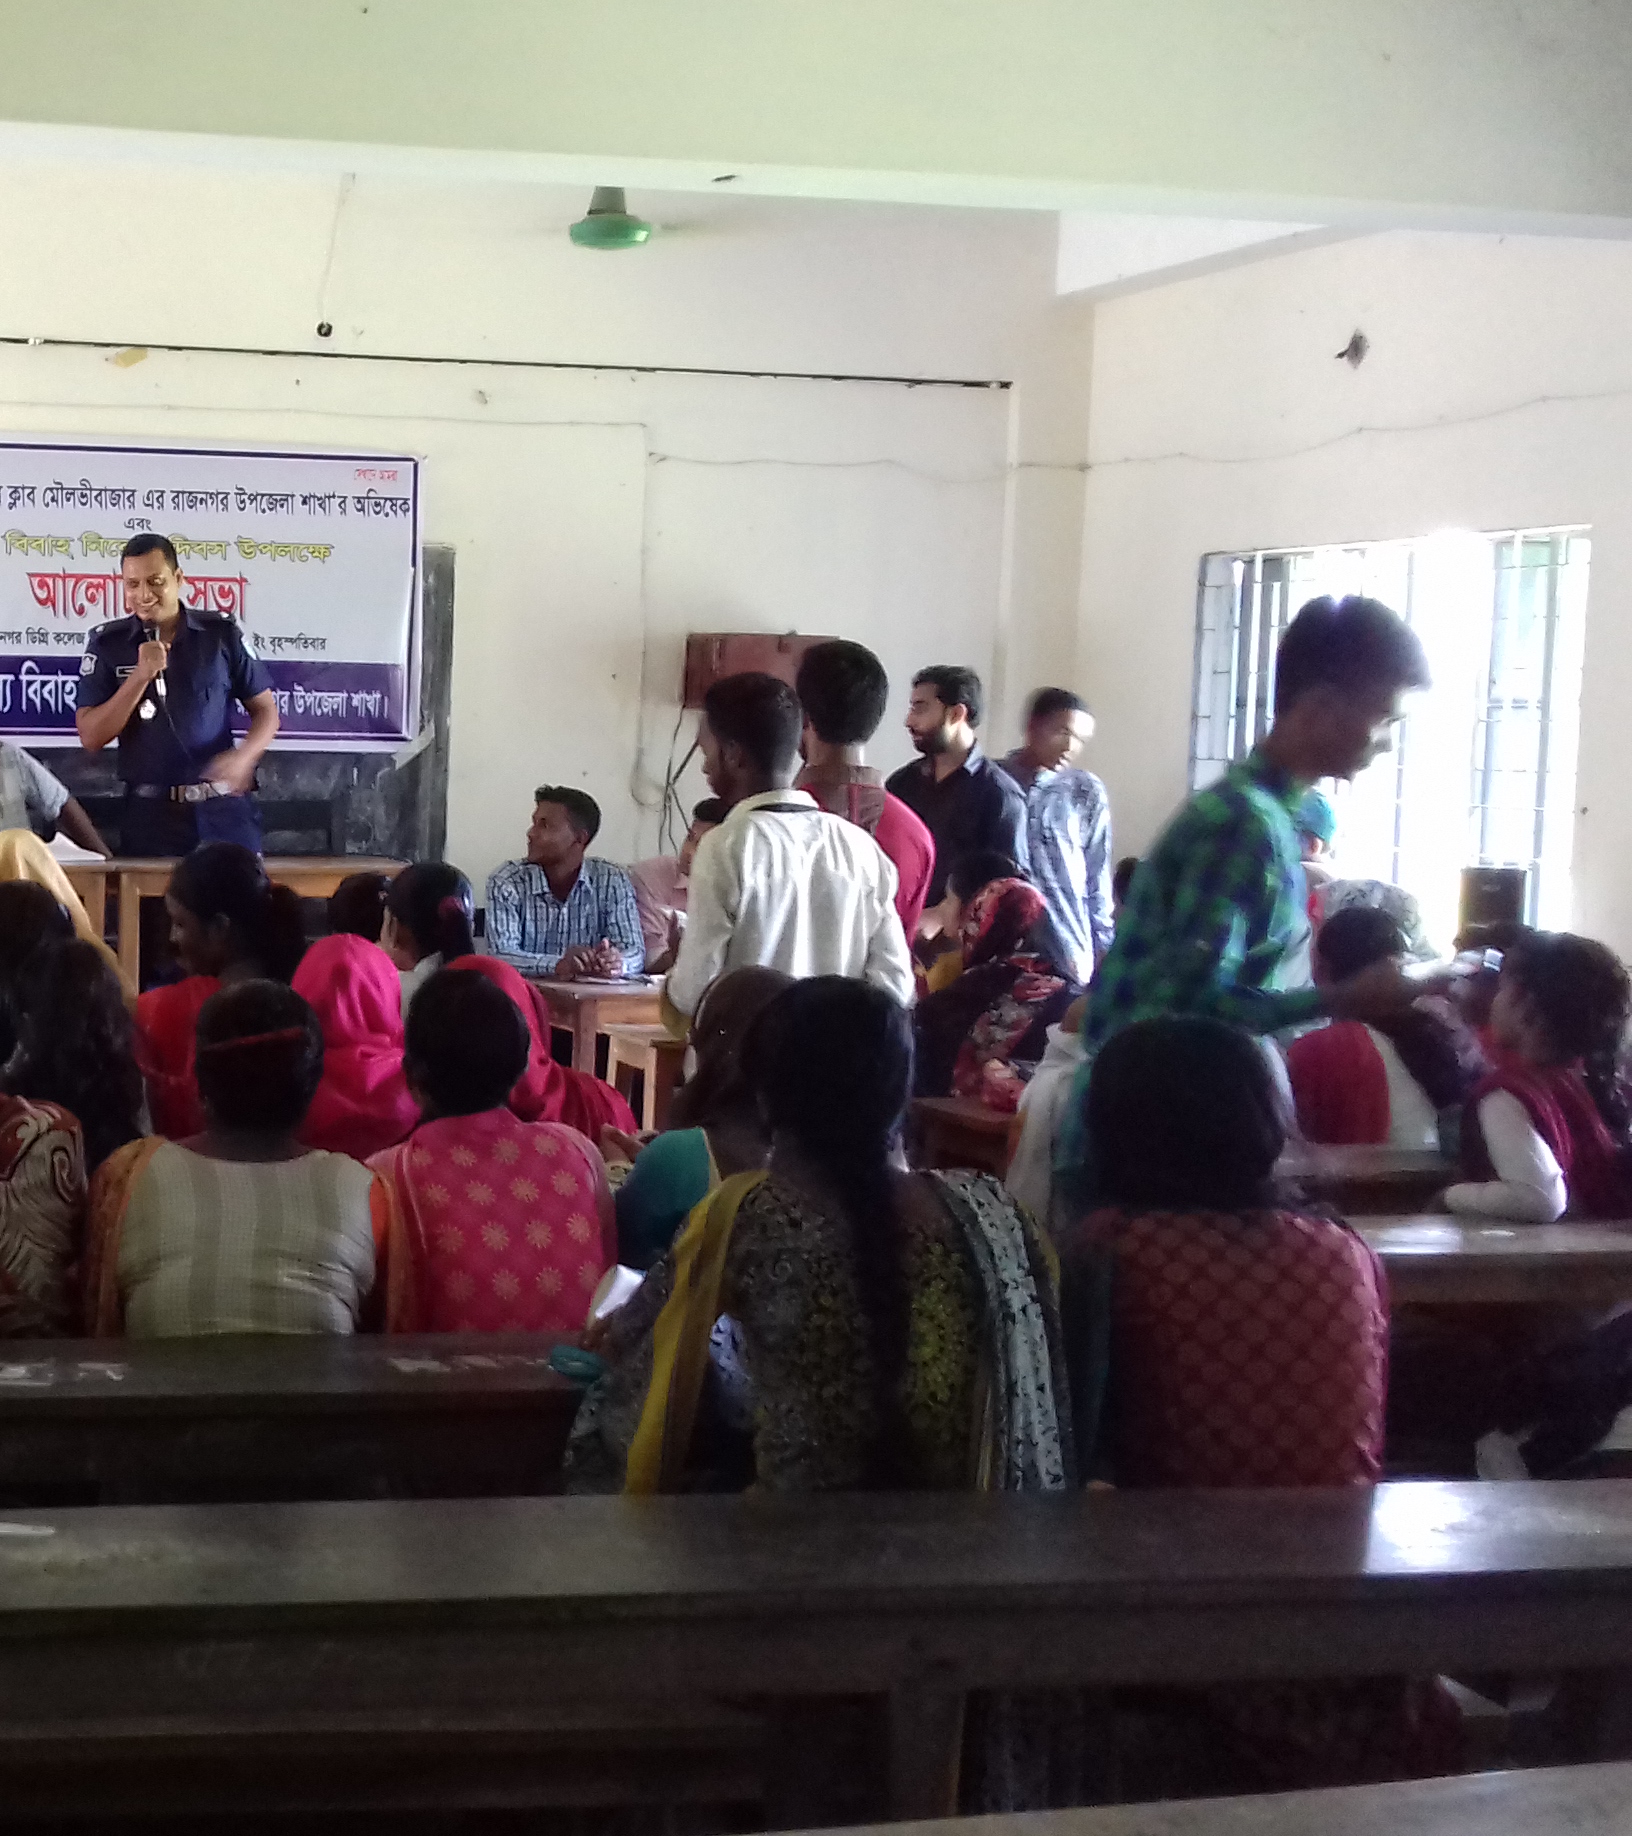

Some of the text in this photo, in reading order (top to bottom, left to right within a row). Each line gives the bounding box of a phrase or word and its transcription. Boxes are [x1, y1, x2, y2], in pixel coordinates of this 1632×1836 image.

[7, 483, 37, 511] ক্লাব
[43, 478, 136, 511] মৌলভীবাজার
[142, 488, 165, 512] এর
[170, 488, 230, 513] রাজনগর
[234, 484, 295, 516] উপজেলা
[352, 487, 410, 518] অভিষেক
[124, 517, 152, 532] এবং
[0, 528, 75, 560] বিবাহ
[234, 535, 335, 564] উপলক্ষে
[269, 632, 328, 655] বৃহস্পতিবার
[19, 660, 80, 714] বিবাহ
[293, 682, 348, 717] উপজেলা
